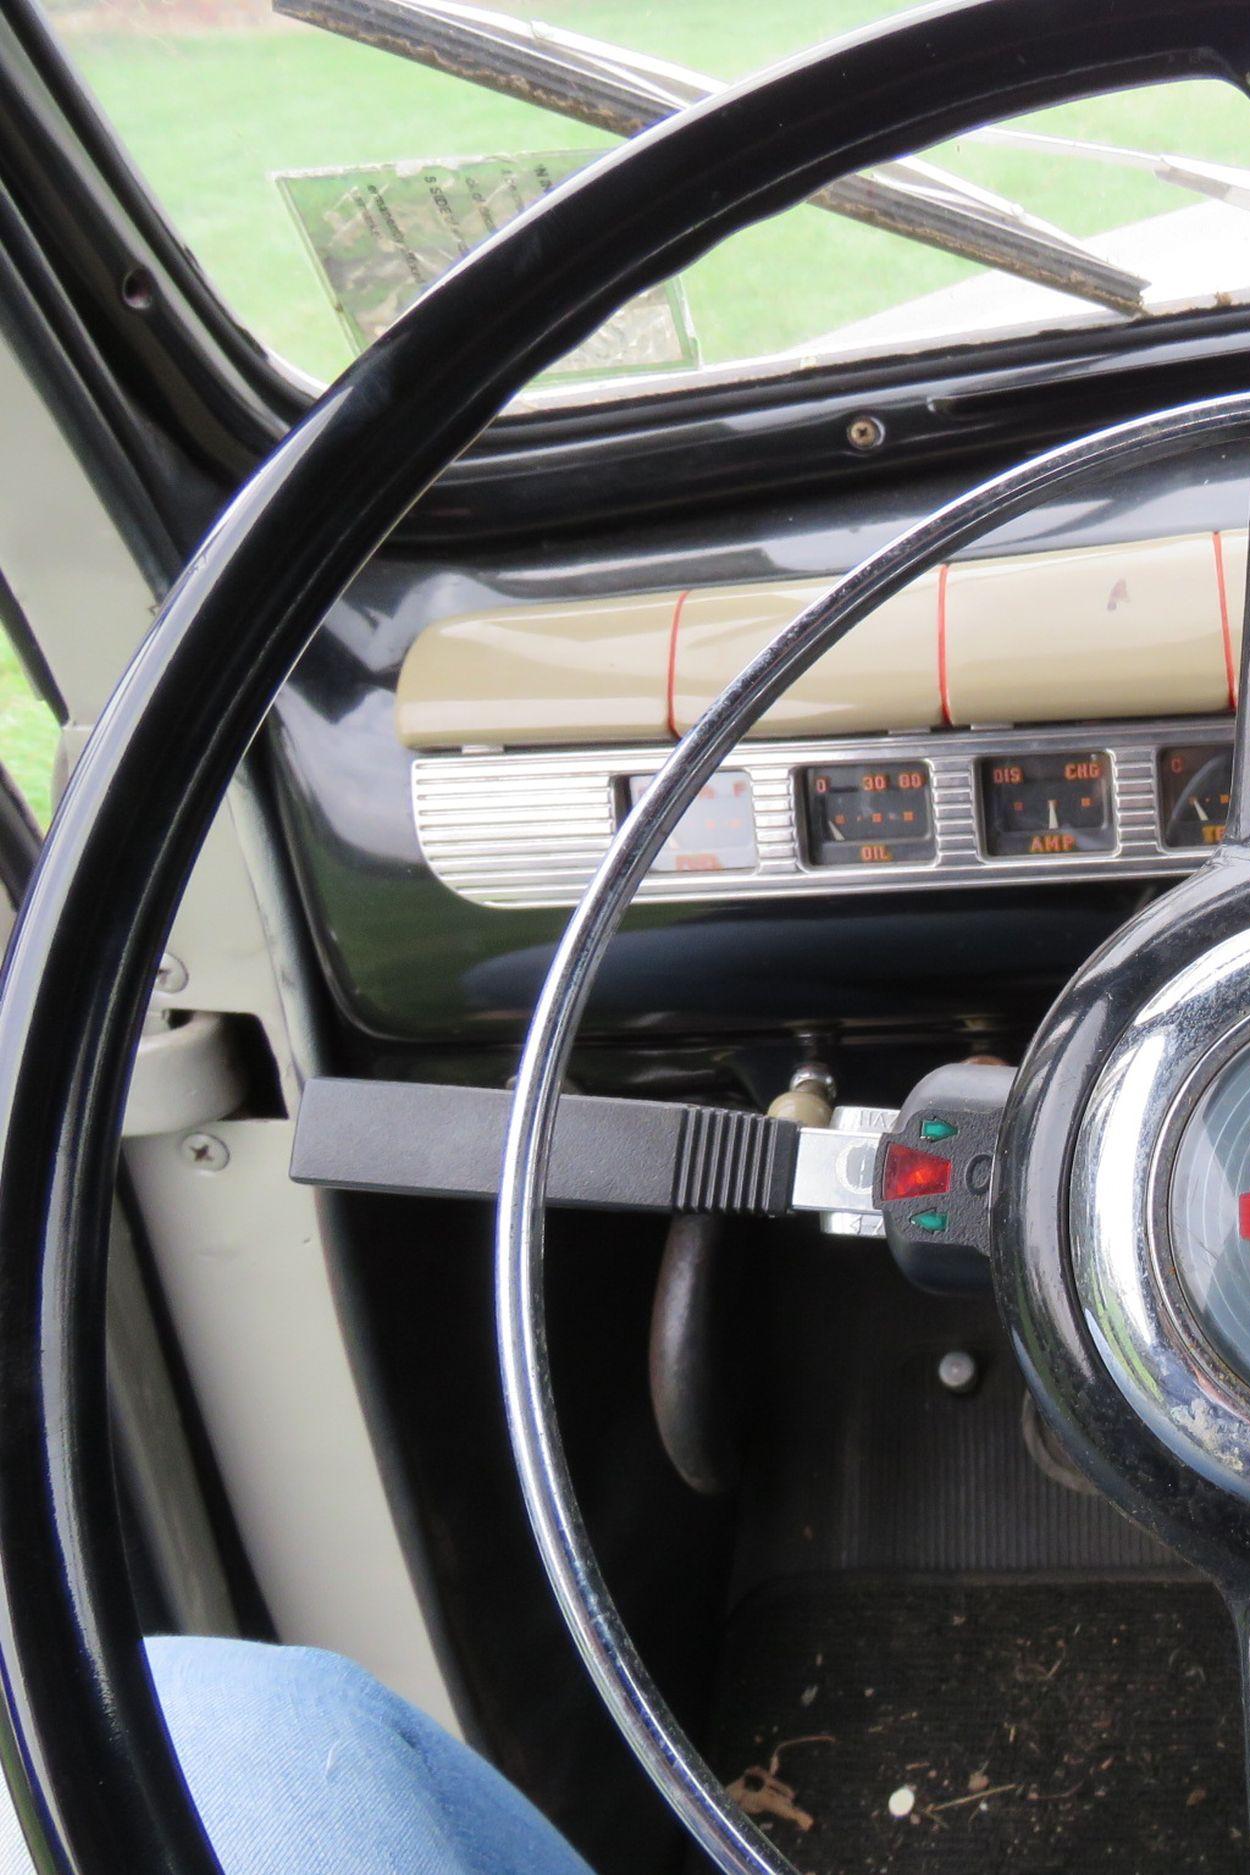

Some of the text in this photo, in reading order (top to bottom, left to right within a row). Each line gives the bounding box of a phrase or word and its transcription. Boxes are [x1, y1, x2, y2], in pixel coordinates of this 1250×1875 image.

[863, 774, 886, 791] 30
[993, 763, 1101, 784] DIS CHG
[1030, 834, 1076, 853] AMP
[862, 846, 890, 861] OIL
